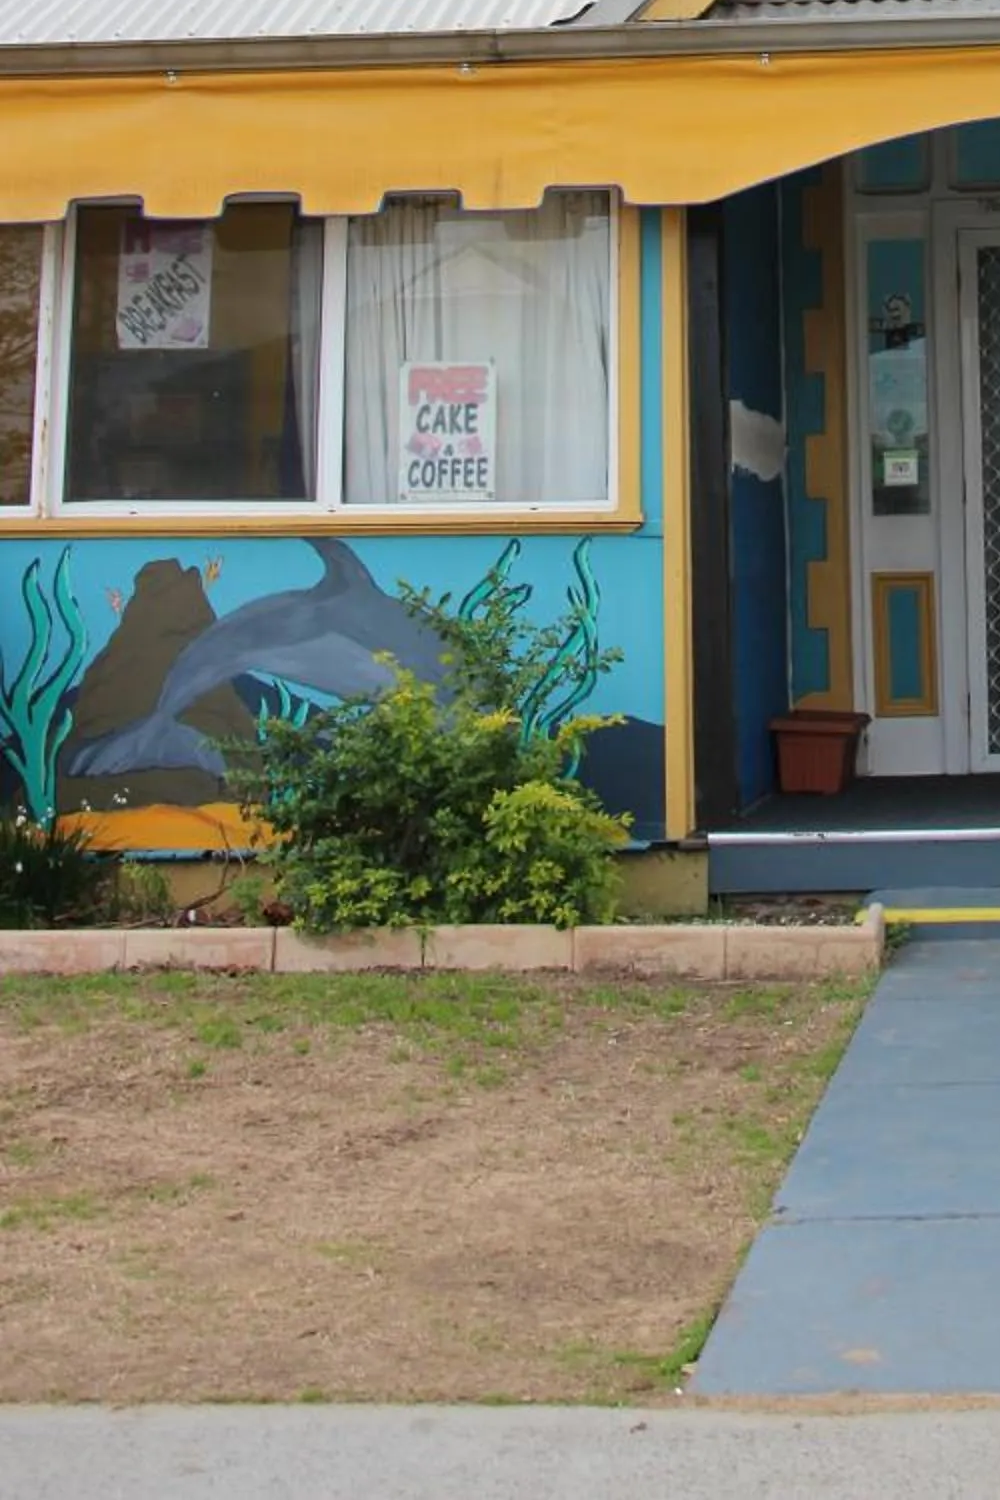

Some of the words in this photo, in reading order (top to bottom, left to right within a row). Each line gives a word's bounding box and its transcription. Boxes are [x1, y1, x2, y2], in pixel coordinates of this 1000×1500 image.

[119, 253, 207, 344] BREAKFAST
[415, 402, 479, 435] CAKE
[407, 457, 489, 489] COFFEE
